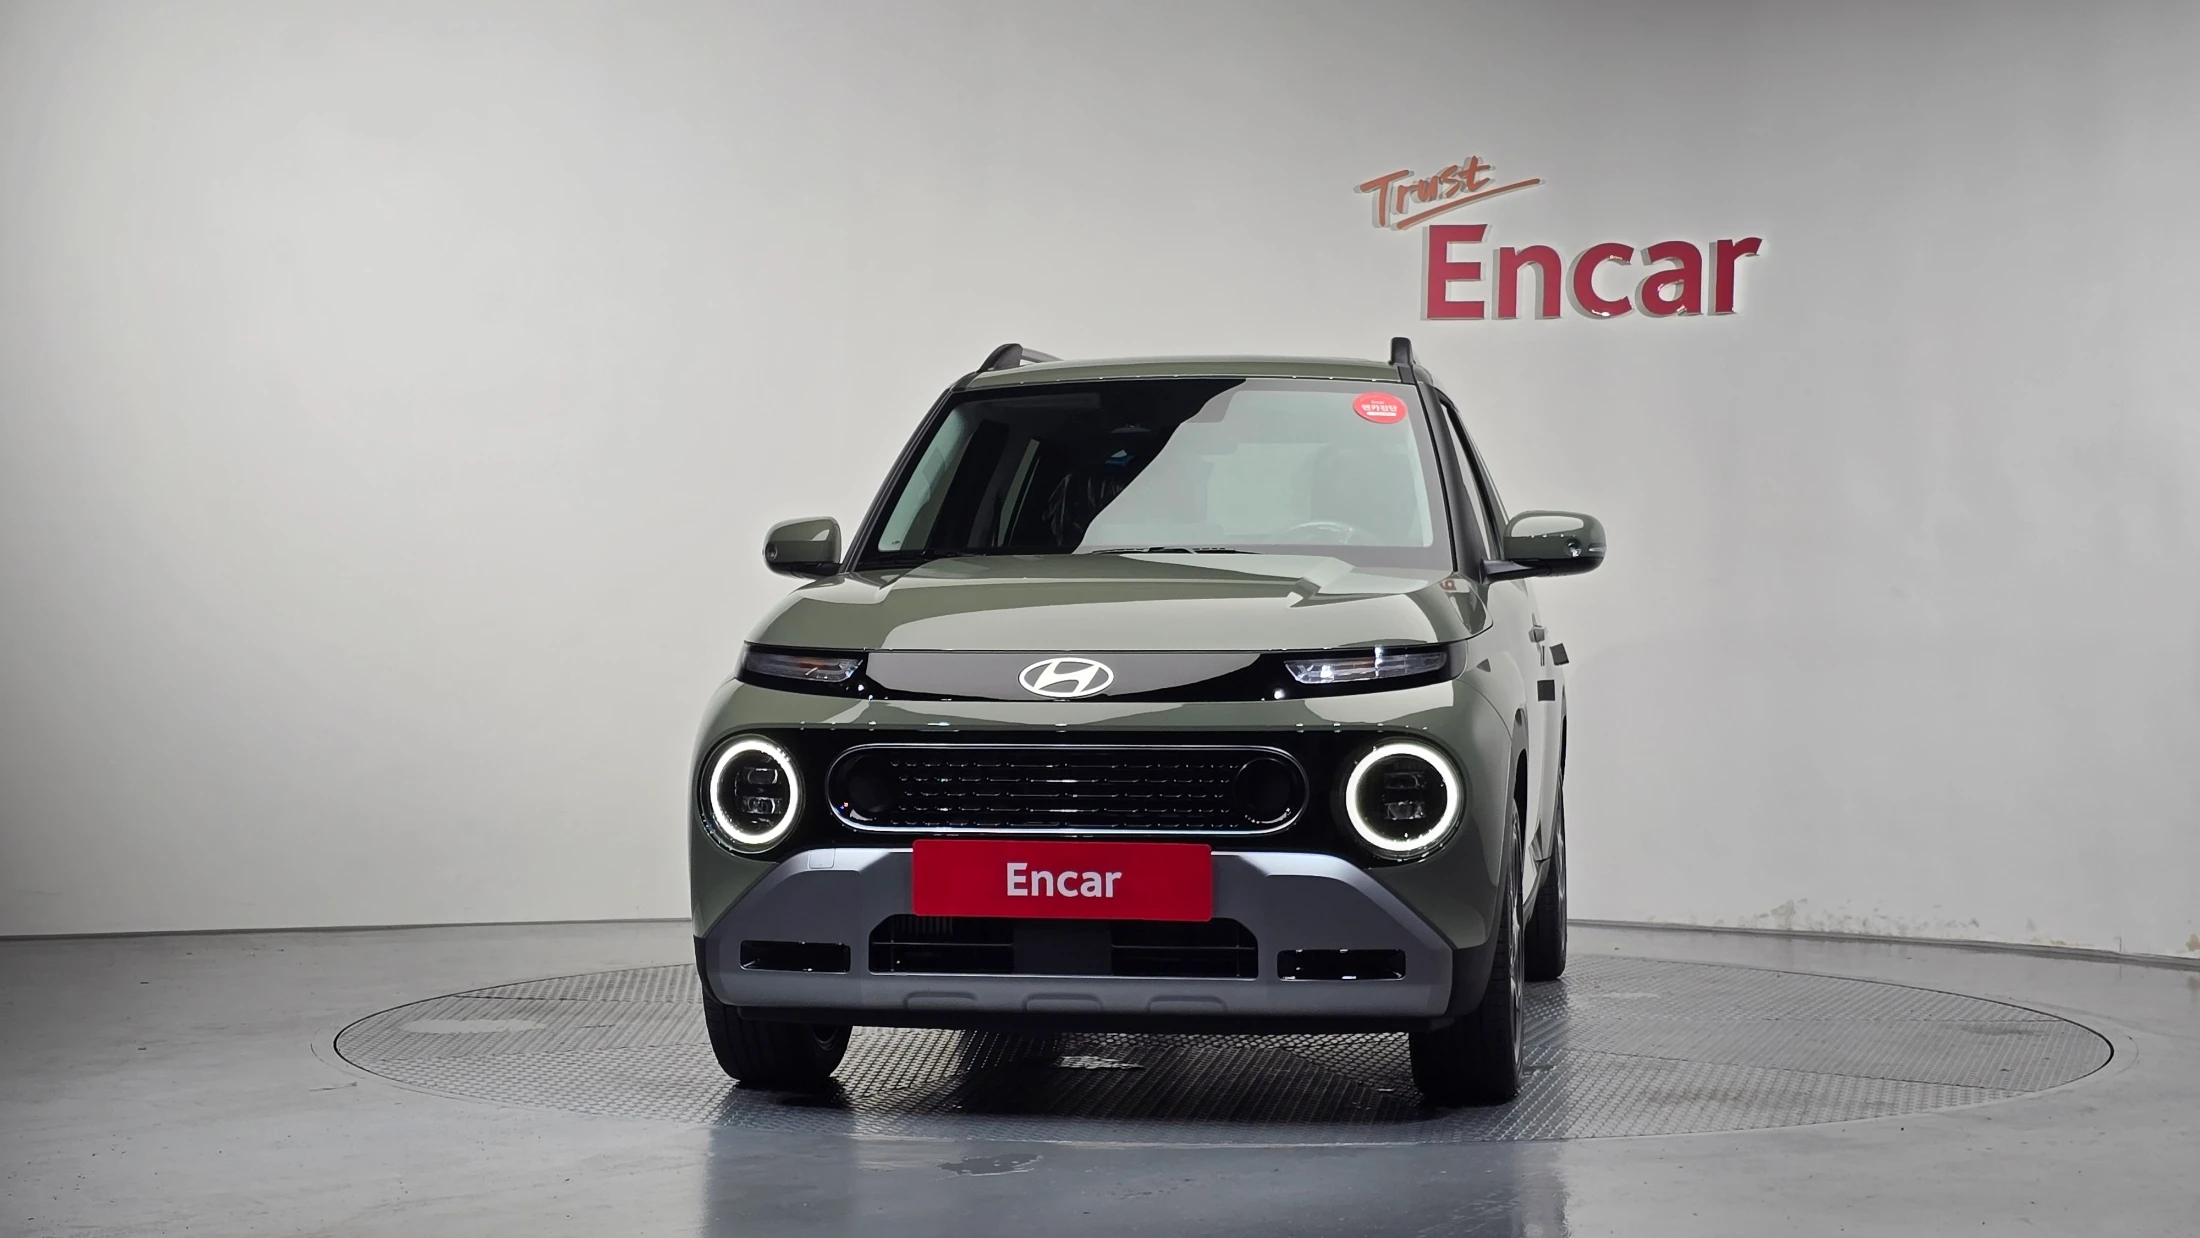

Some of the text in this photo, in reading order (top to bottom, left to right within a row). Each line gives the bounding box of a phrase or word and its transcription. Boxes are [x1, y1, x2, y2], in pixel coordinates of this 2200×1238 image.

[1359, 155, 1492, 227] Trust
[1425, 223, 1762, 319] Encar
[1006, 862, 1122, 898] Encar
